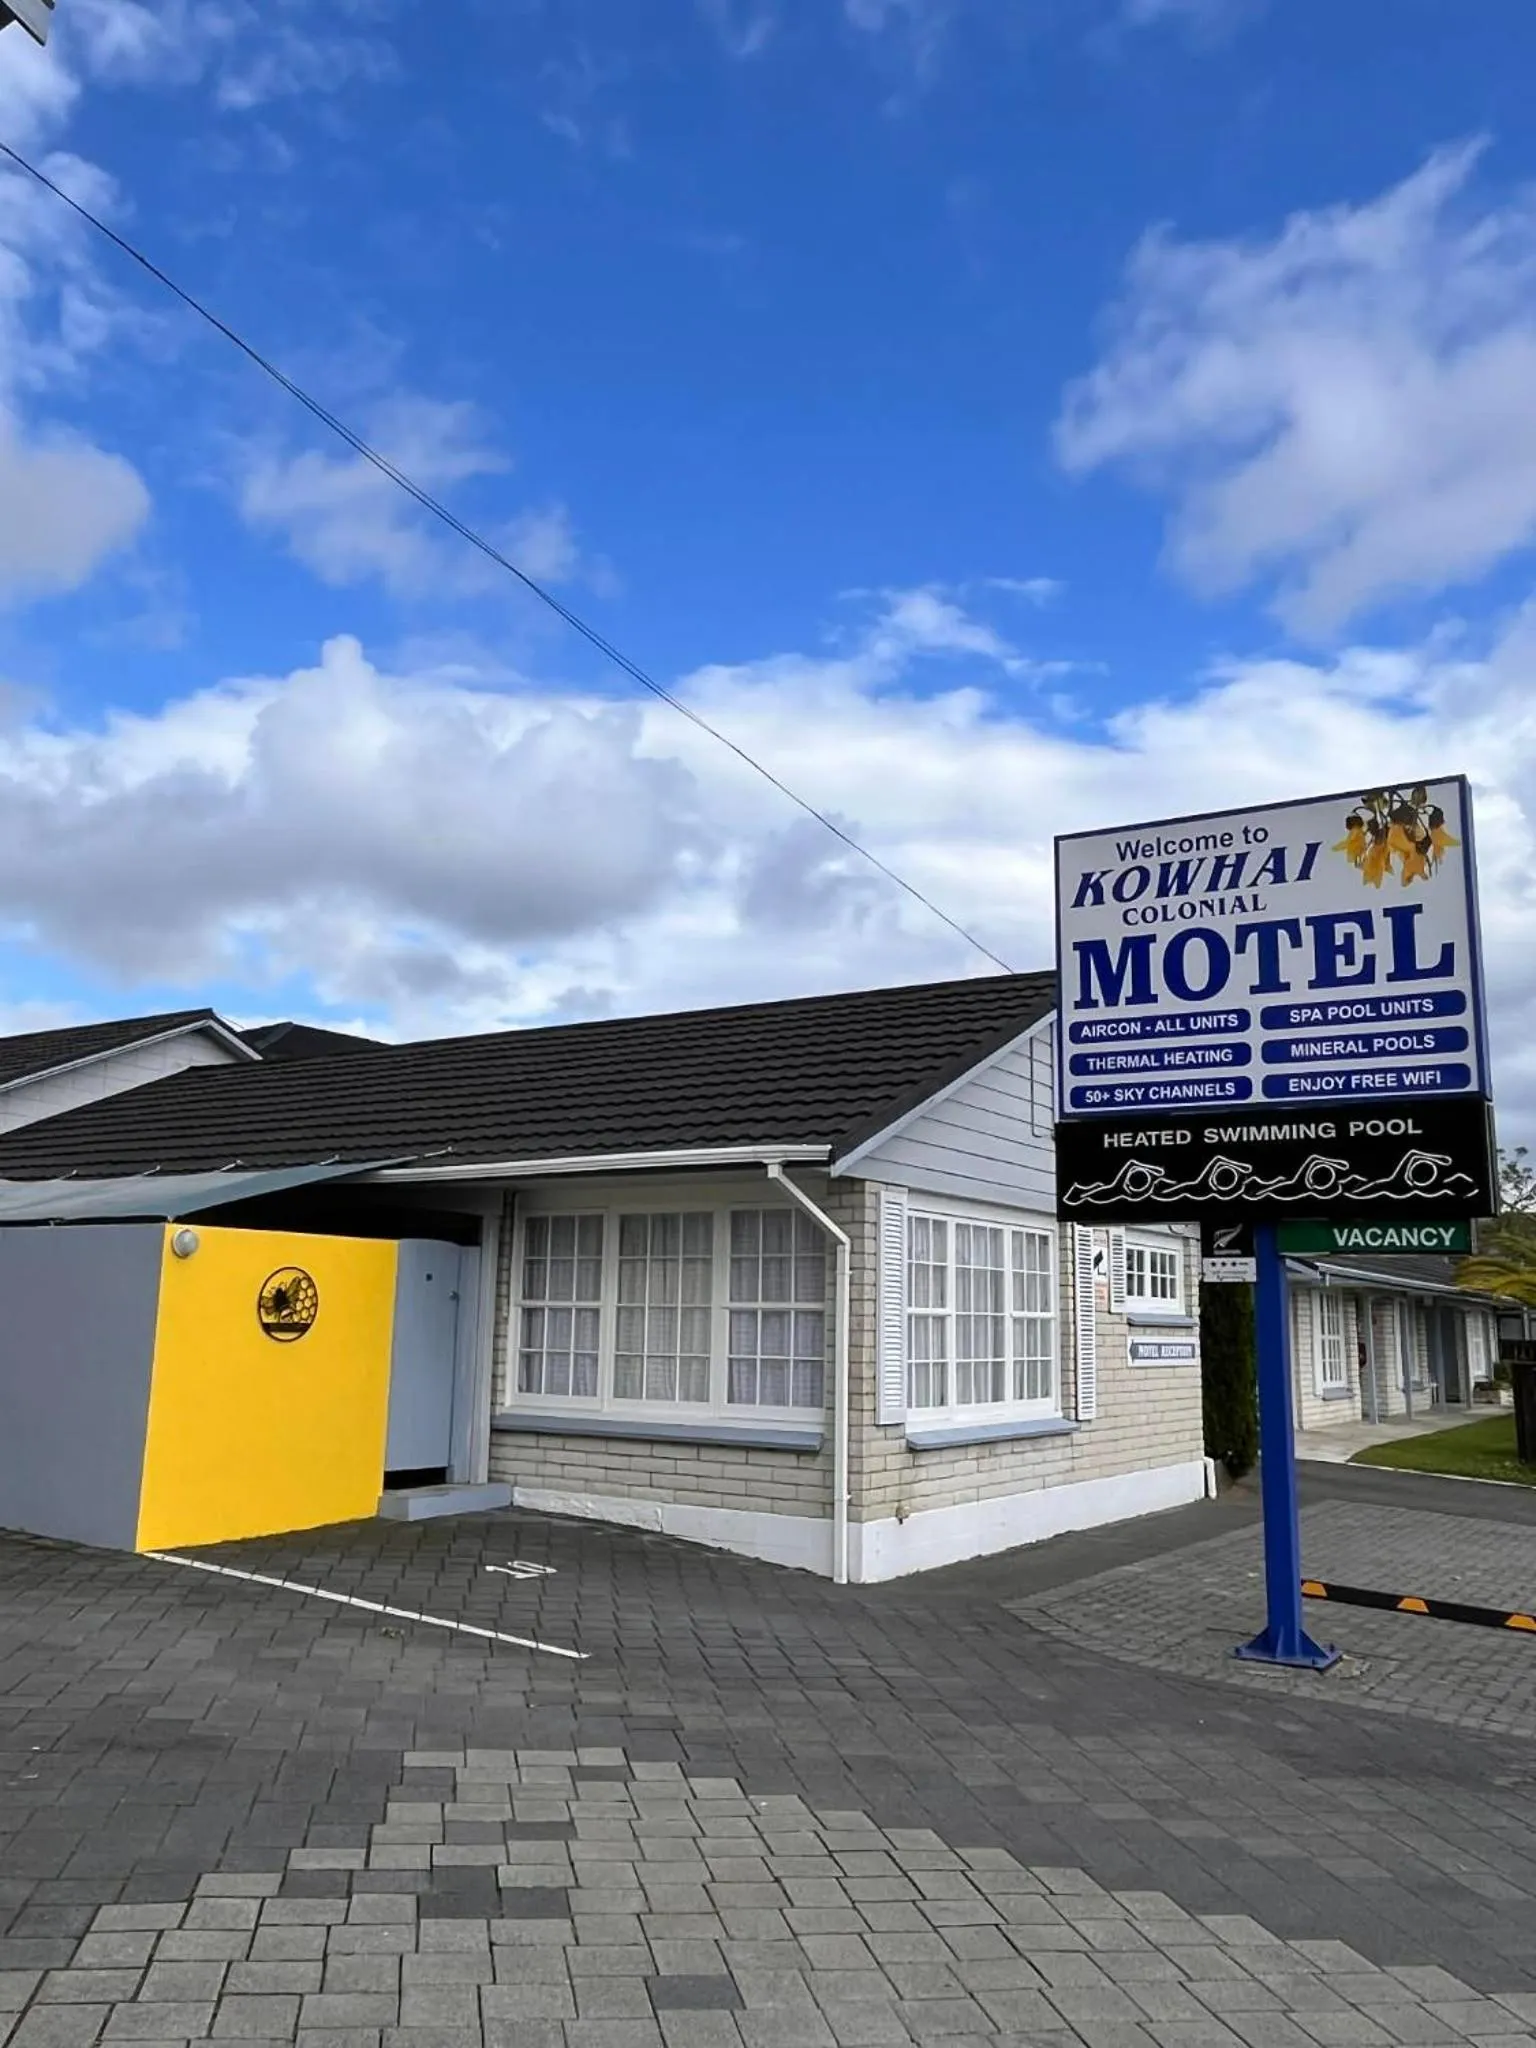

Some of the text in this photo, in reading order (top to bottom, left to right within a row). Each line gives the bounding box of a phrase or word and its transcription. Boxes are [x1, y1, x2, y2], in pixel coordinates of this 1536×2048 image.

[1116, 825, 1269, 862] Welcome to
[1070, 841, 1323, 908] KOWHAI
[1122, 894, 1267, 926] COLONIAL
[1072, 903, 1456, 1010] MOTEL
[1289, 998, 1434, 1023] SPA POOL UNITS
[1081, 1021, 1141, 1038] AIRCON
[1155, 1018, 1185, 1033] ALL
[1190, 1013, 1239, 1030] UNITS
[1291, 1034, 1435, 1057] MINERAL POOLS
[1087, 1048, 1233, 1071] THERMAL HEATING
[1085, 1082, 1235, 1103] 50+ SKY CHANNELS
[1289, 1070, 1441, 1092] ENJOY FREE WIFI
[1103, 1118, 1423, 1148] HEATED SWIMMING POOL
[1333, 1227, 1456, 1248] VACANCY
